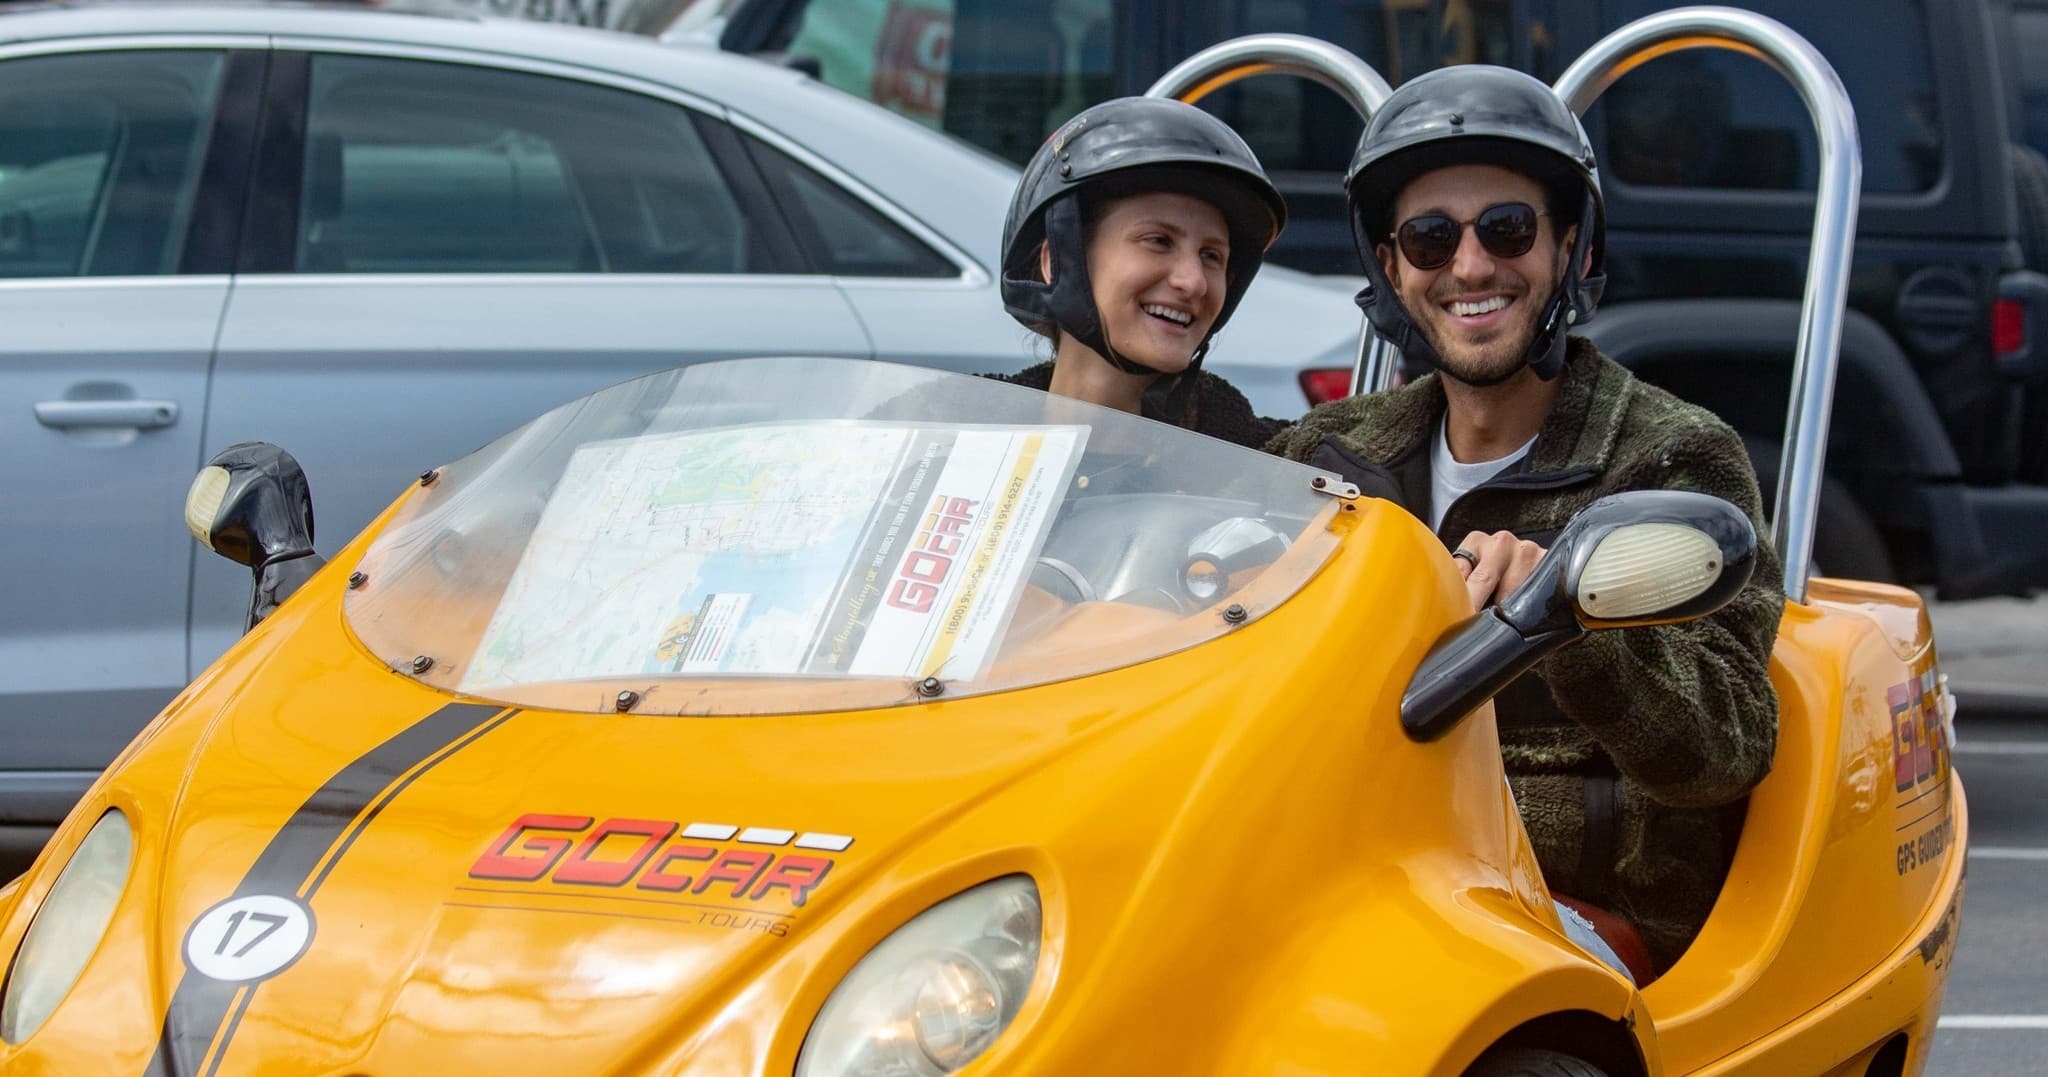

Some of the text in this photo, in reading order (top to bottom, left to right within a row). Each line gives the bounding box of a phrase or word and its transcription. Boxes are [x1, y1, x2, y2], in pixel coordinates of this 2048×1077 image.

[886, 496, 979, 613] GOCAR
[468, 813, 835, 906] GOCAR
[214, 909, 288, 958] 17
[697, 910, 791, 938] TOURS
